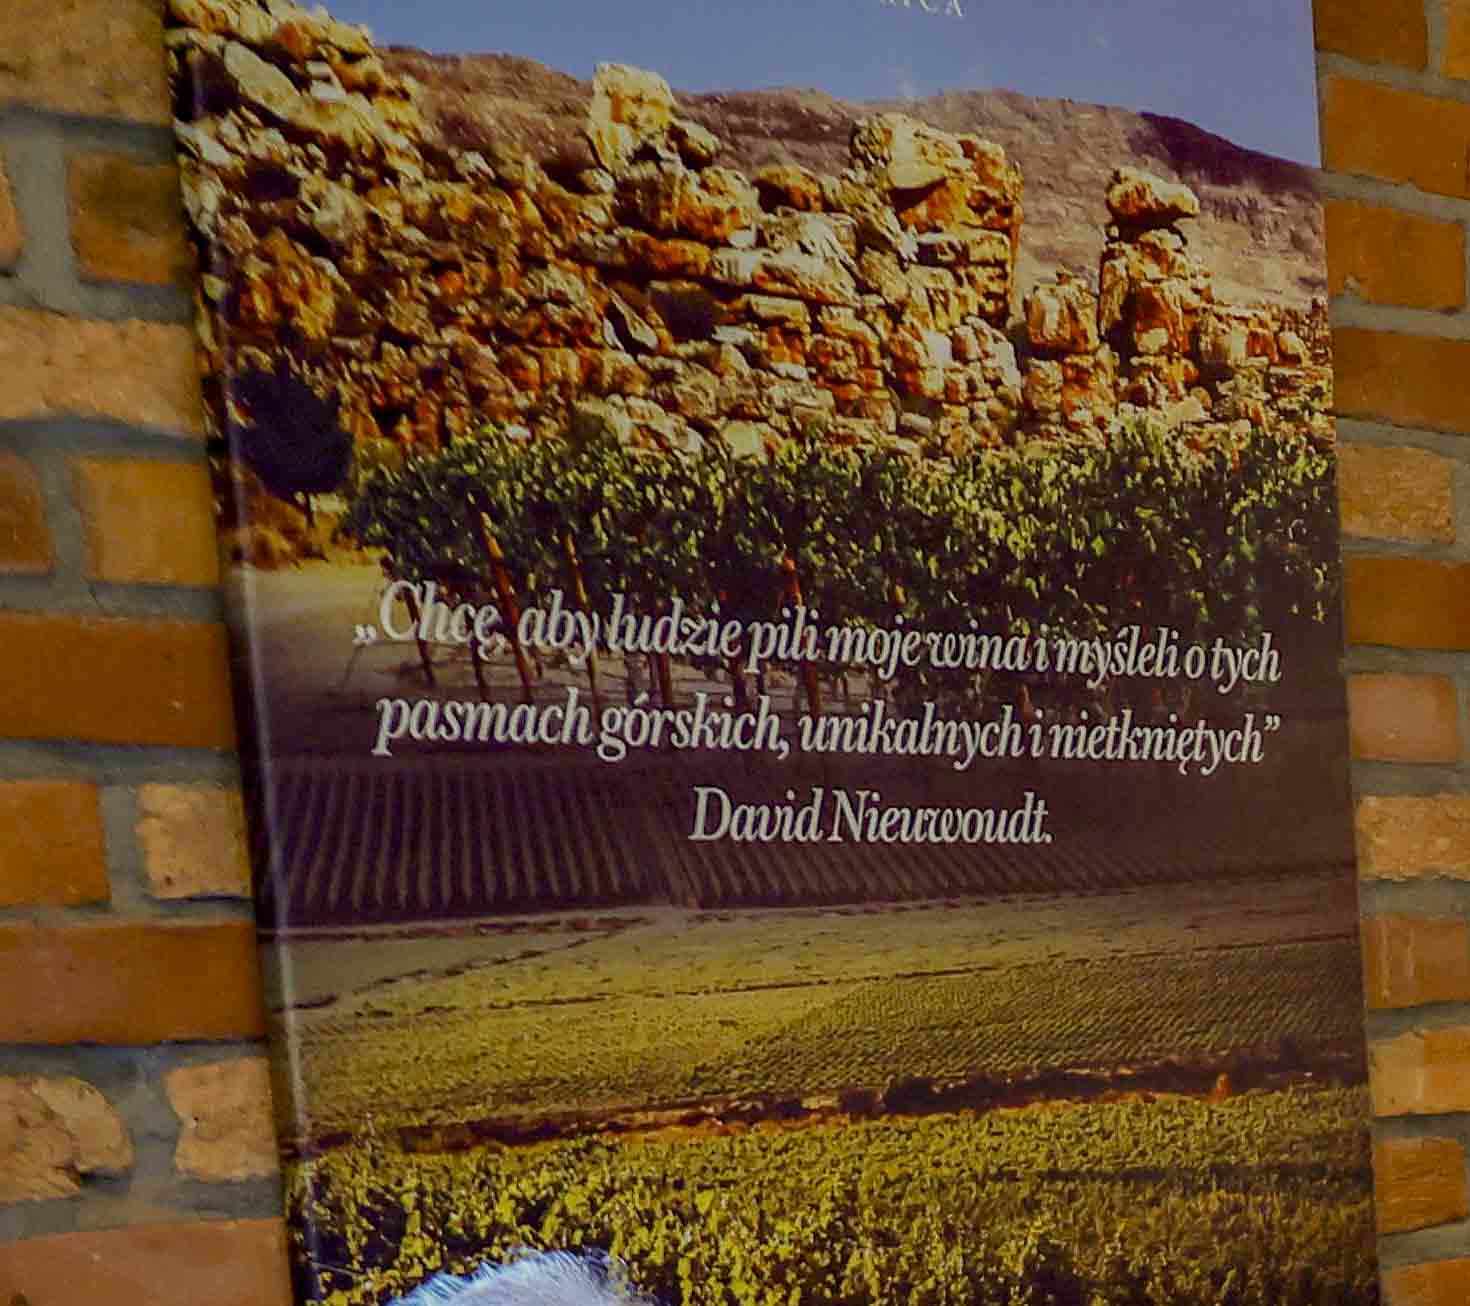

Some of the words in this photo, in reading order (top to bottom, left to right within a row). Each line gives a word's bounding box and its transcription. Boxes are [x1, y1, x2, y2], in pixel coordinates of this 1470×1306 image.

[516, 589, 599, 665] aby
[608, 593, 743, 658] ludzie
[744, 602, 819, 674] pili
[825, 615, 921, 680] moje
[926, 617, 1029, 671] wina
[1030, 621, 1050, 672] i
[1055, 624, 1181, 688] myśleli
[1184, 644, 1204, 679] o
[1210, 631, 1282, 694] tych
[371, 687, 593, 756] pasmach
[597, 692, 790, 762] górskich,
[797, 700, 1026, 770] unikalnych
[1028, 709, 1047, 757] i
[688, 786, 822, 842] David
[830, 789, 1055, 844] Nieuwoudt.
